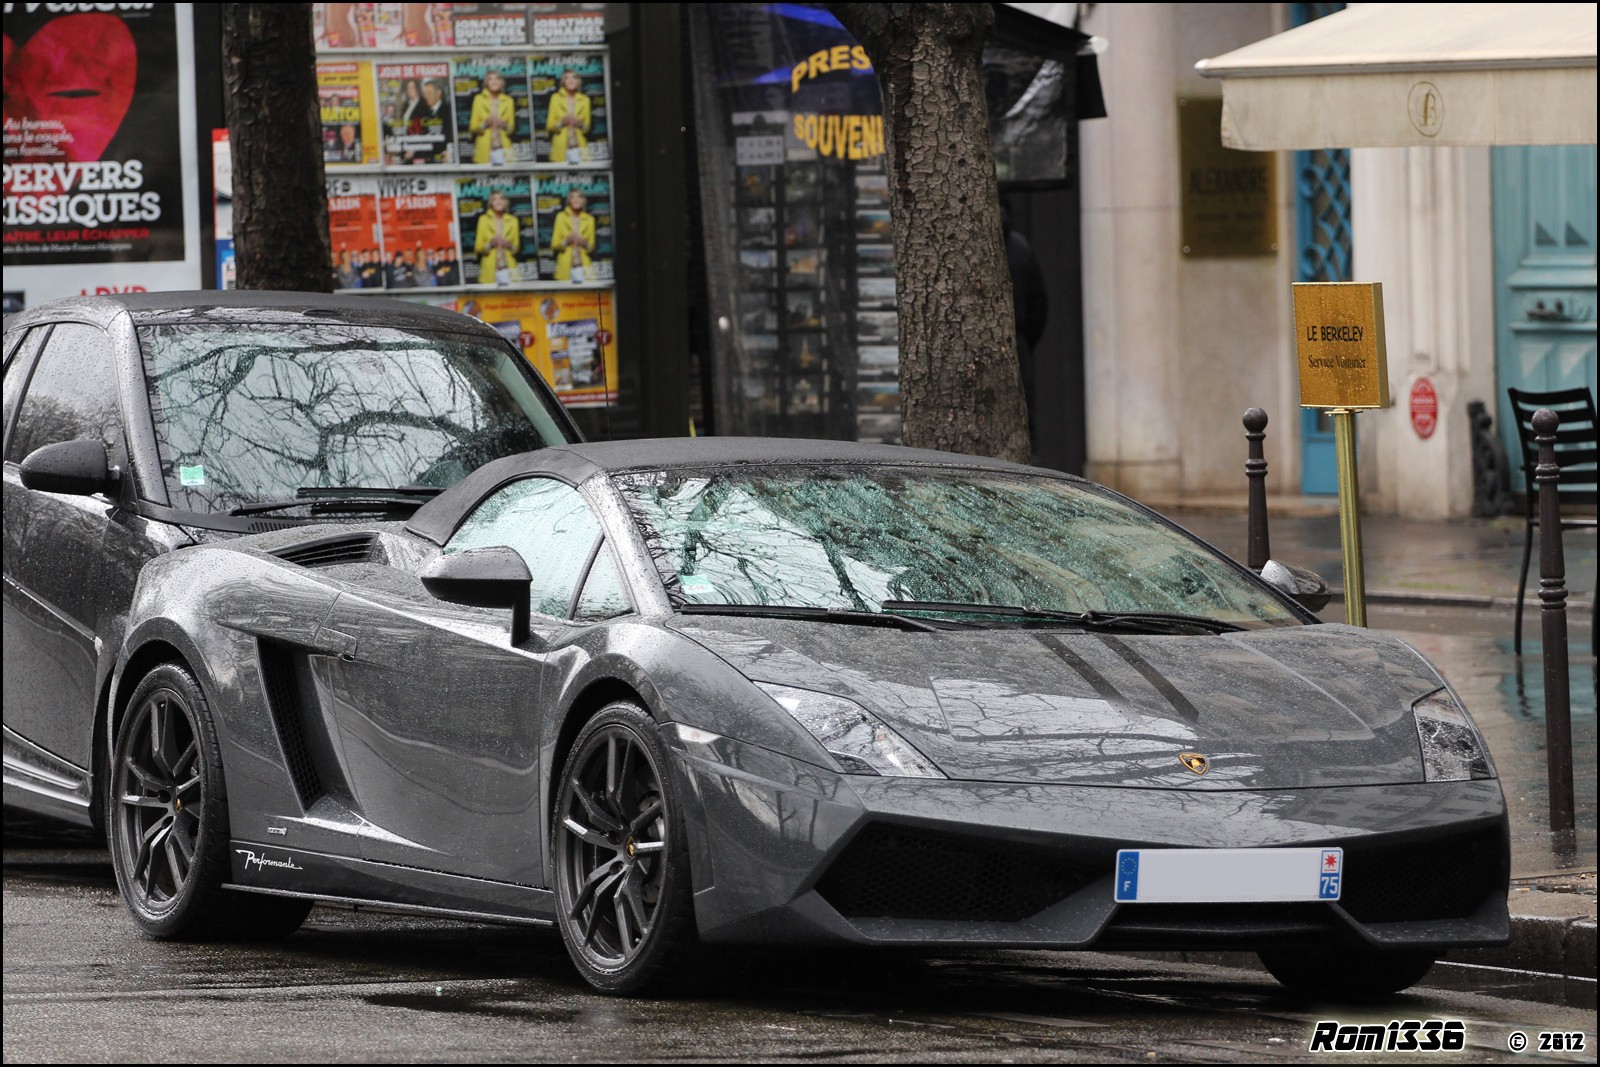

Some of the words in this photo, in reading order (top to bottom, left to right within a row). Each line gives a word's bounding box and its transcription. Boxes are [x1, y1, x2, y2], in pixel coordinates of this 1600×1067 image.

[5, 118, 20, 130] Au
[3, 192, 161, 228] ISSIQUES
[1307, 326, 1318, 341] LE
[1321, 326, 1363, 341] BERKELEY
[1308, 354, 1334, 368] Service
[235, 849, 303, 871] Performante
[1124, 881, 1131, 892] F
[1321, 876, 1338, 895] 75
